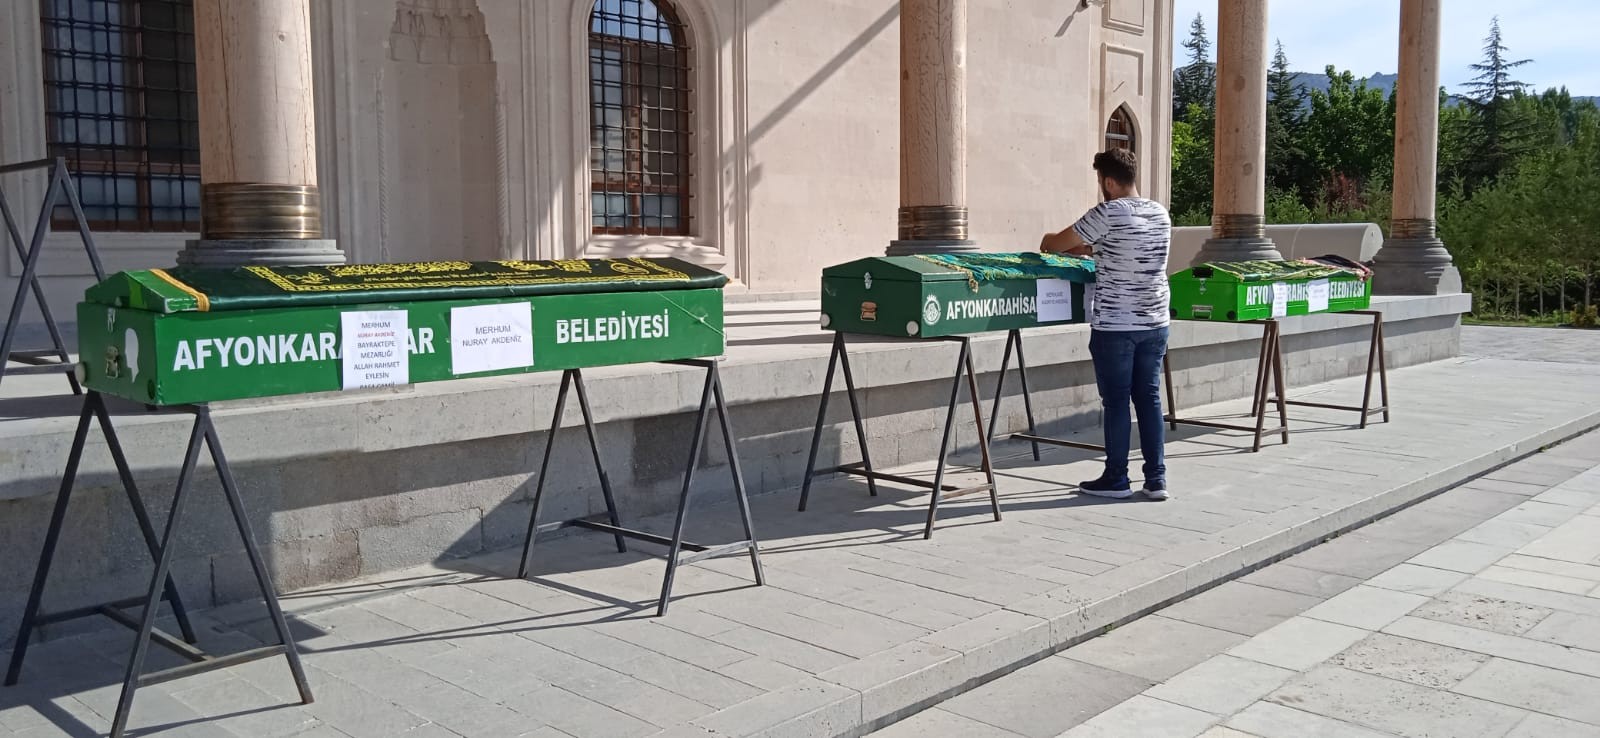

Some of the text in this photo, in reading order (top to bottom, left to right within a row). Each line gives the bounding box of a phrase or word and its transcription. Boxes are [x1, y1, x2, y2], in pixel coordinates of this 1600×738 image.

[1330, 280, 1366, 299] ELEDİYESİ
[946, 292, 1037, 320] AFYONKARAHİSA
[361, 321, 391, 329] MERHUM
[475, 324, 511, 334] MERHUM
[173, 308, 669, 372] AFYONKARAR BELEDİYESİ
[462, 334, 522, 347] NURAY AKDENİZ
[360, 350, 393, 359] MEZARLIĞI
[374, 361, 400, 369] RAHMET
[365, 371, 389, 379] EYLESİN
